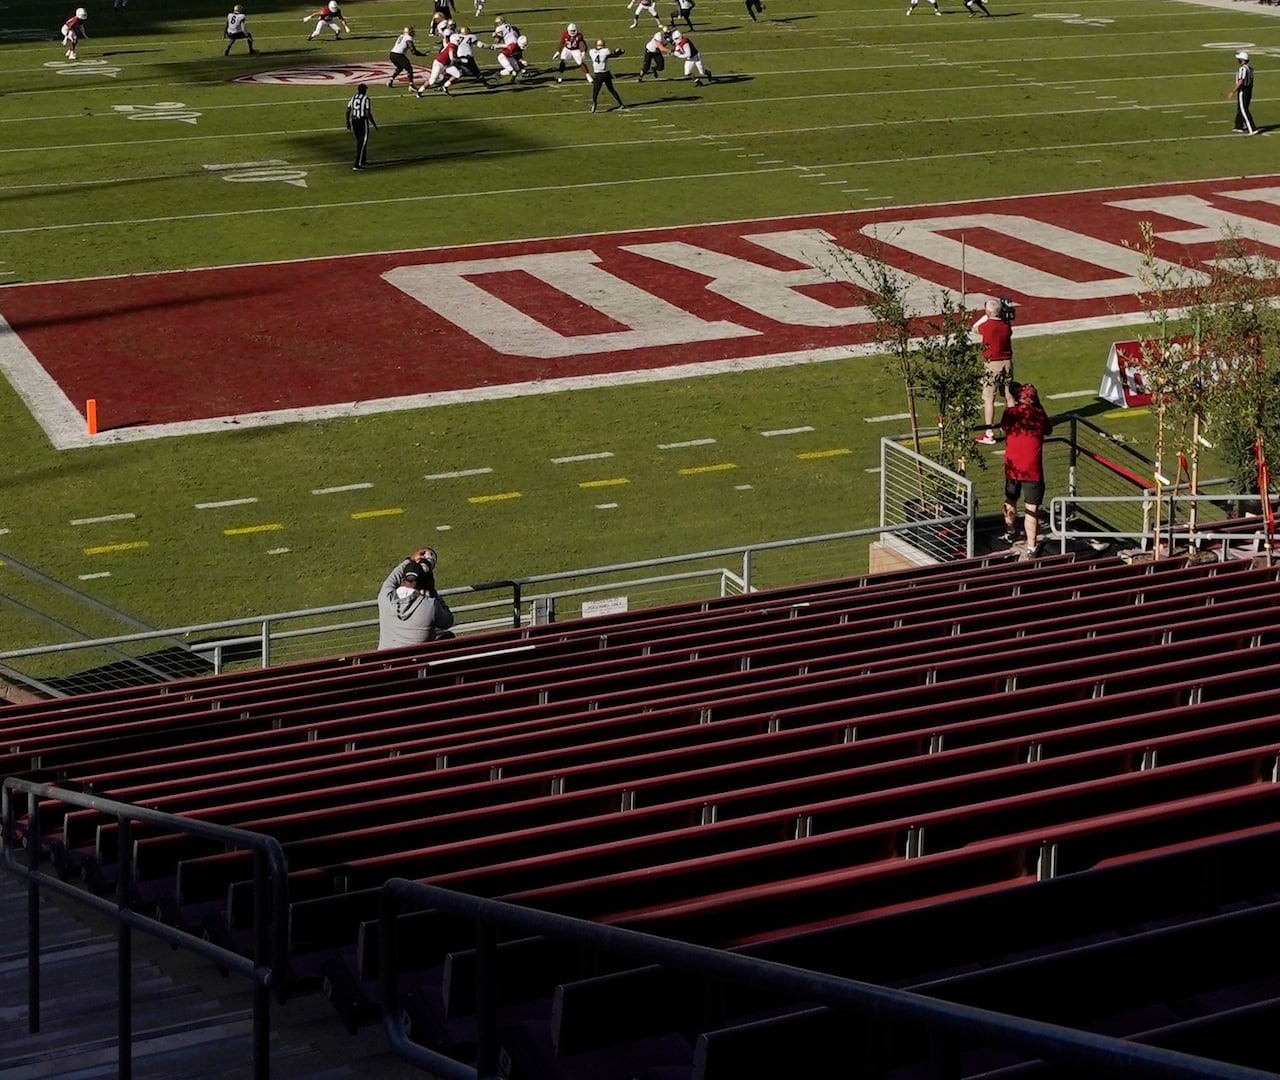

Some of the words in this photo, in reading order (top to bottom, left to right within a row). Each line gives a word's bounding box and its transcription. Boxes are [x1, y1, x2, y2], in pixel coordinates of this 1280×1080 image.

[231, 15, 237, 25] 6
[594, 55, 601, 64] 4
[354, 99, 361, 110] C
